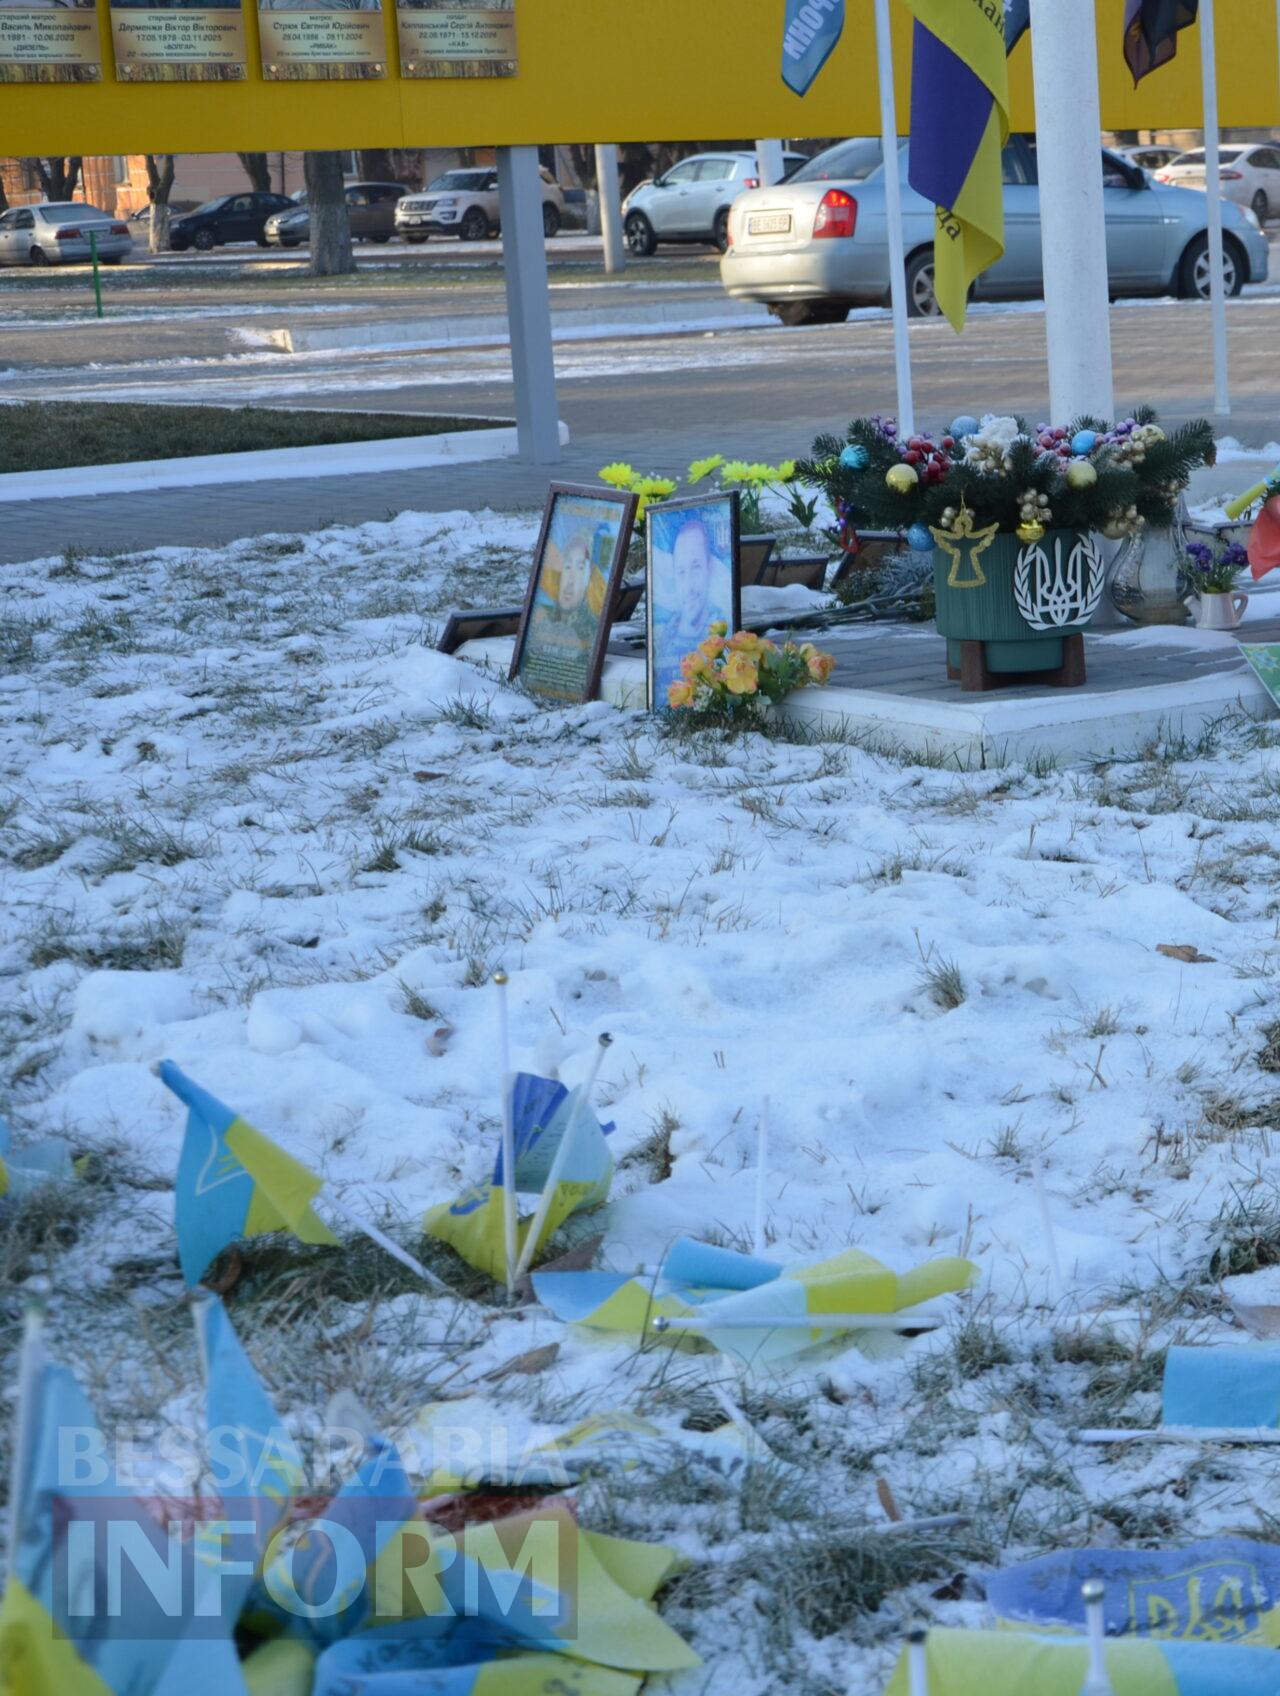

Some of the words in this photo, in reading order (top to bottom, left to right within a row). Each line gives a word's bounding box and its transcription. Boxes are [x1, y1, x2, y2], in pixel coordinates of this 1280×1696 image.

[1, 22, 32, 31] Василь
[34, 22, 91, 31] Миколайович
[164, 23, 191, 32] Віктор
[193, 23, 237, 32] Вікторович
[332, 22, 370, 30] Юрійович
[450, 21, 473, 30] Сергій
[475, 21, 512, 29] Антонович
